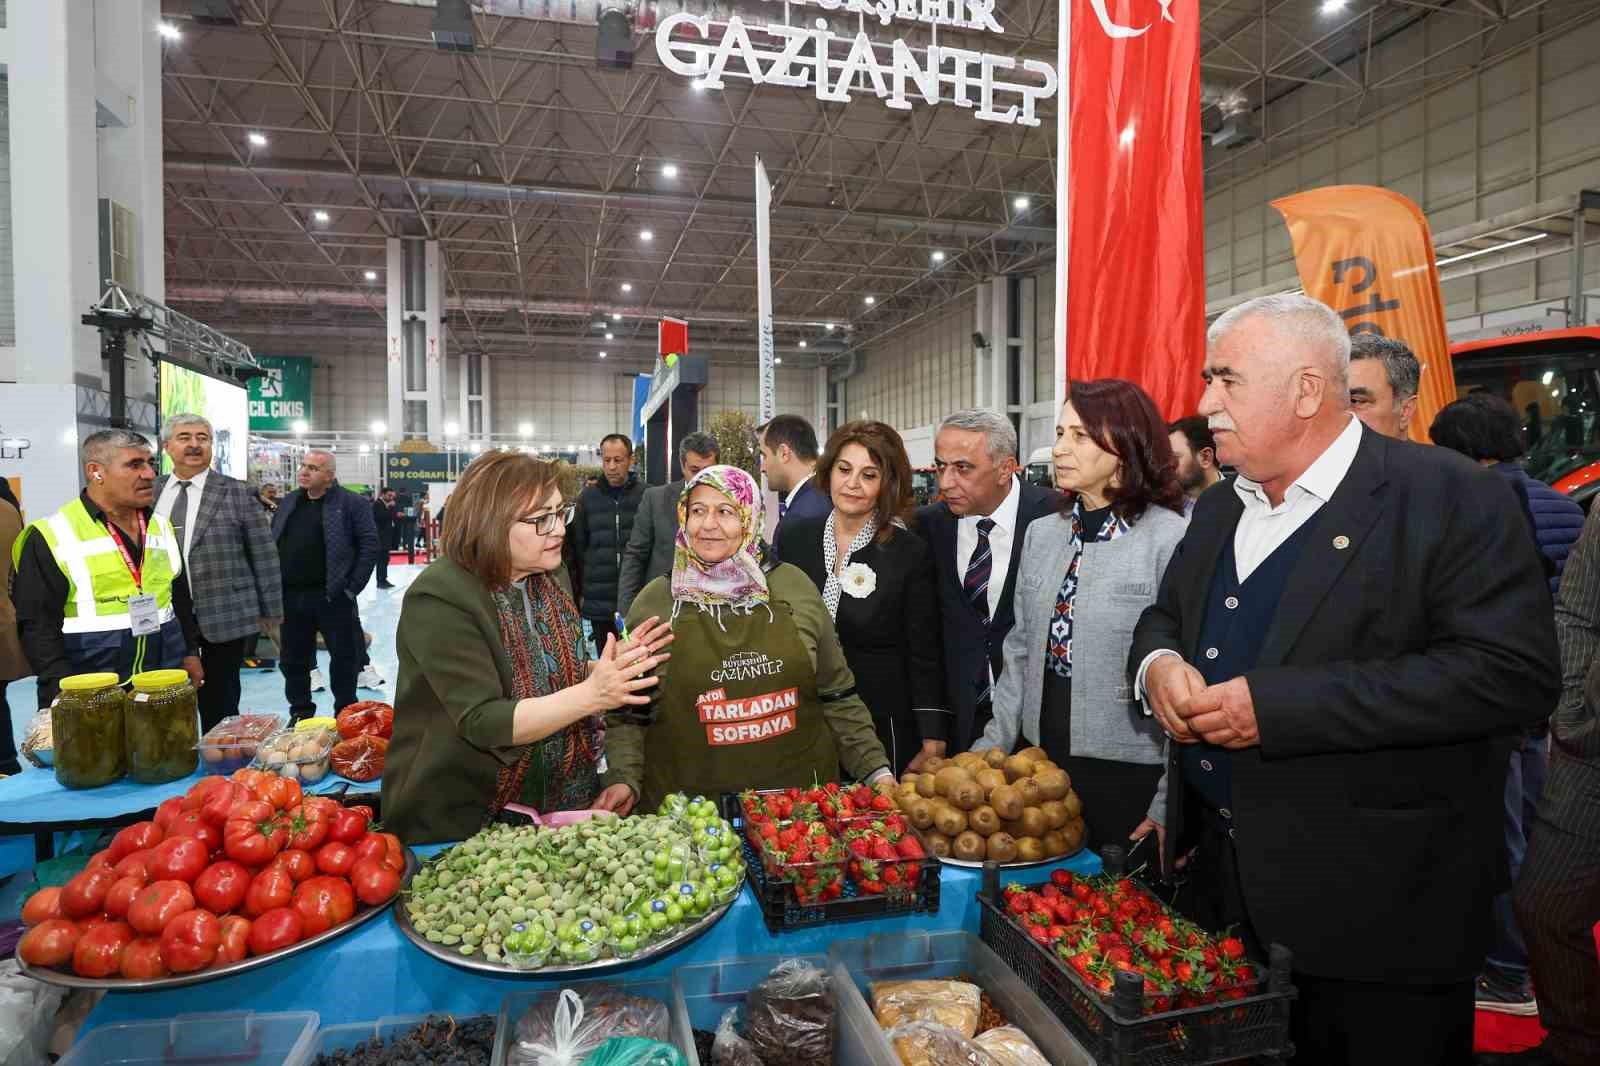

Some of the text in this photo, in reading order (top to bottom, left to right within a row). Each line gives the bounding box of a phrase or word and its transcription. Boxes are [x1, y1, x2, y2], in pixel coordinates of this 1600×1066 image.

[655, 12, 1058, 127] GAZİANTEP
[702, 691, 796, 720] TARLADAN
[713, 715, 793, 742] SOFRAYA
